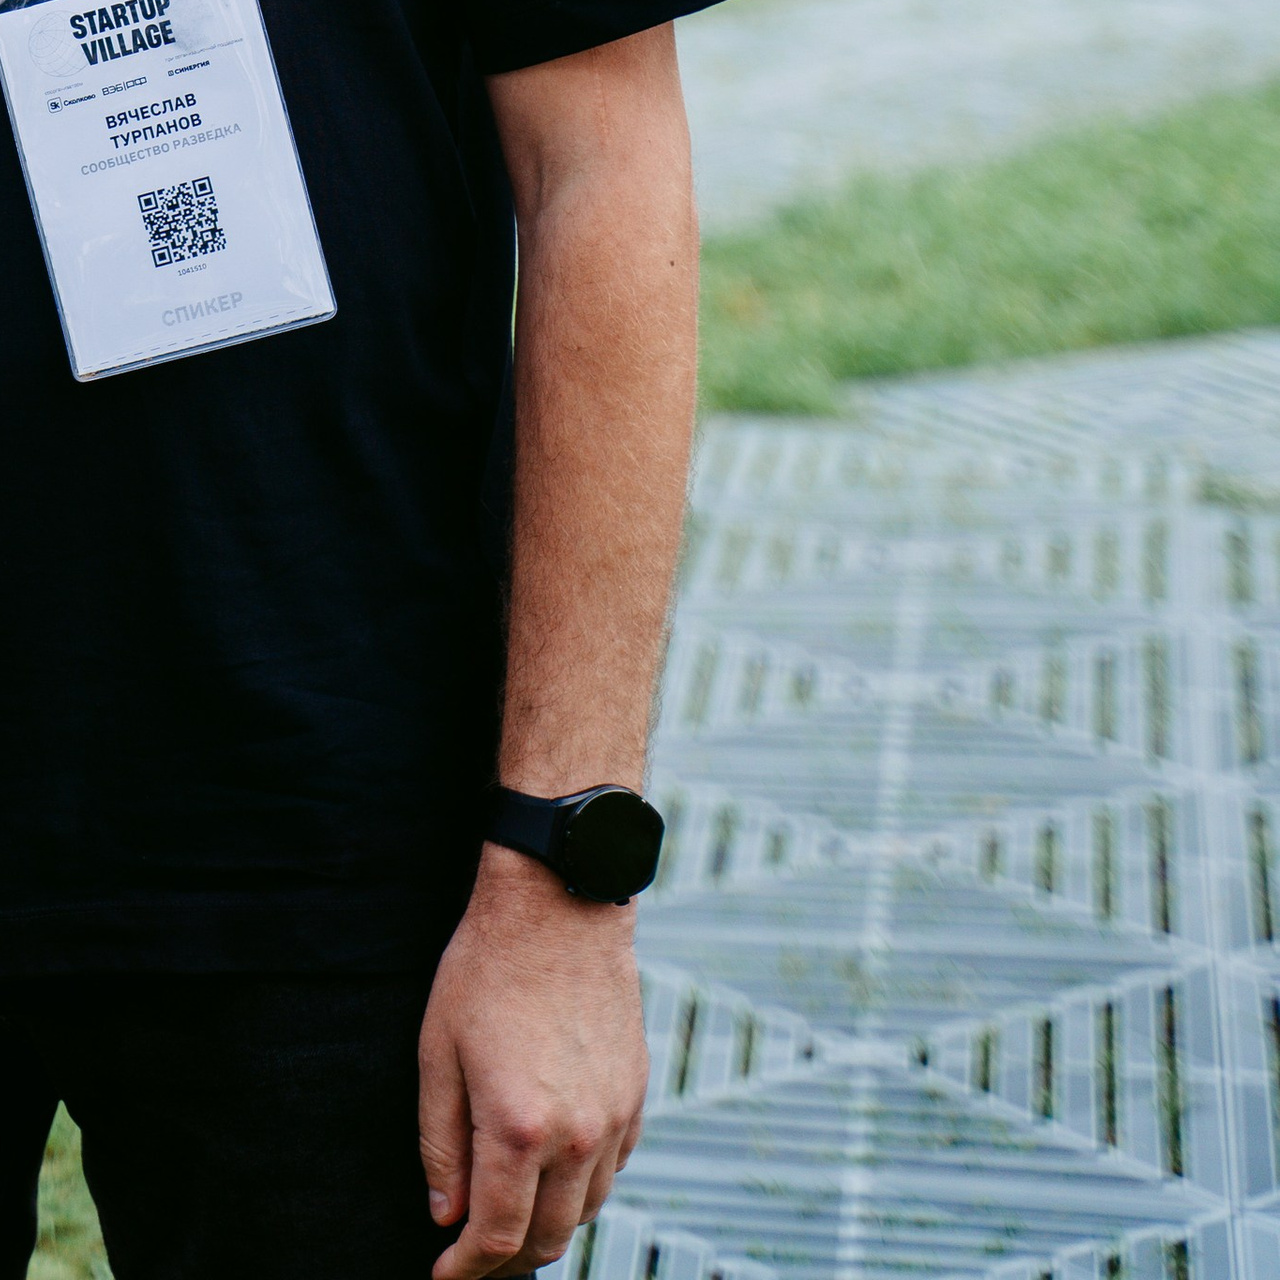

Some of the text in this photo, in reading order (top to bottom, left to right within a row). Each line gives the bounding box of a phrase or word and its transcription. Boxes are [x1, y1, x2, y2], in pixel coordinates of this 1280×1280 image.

[81, 20, 176, 66] VILLAGE
[174, 60, 211, 75] СИНЕРГИЯ
[63, 93, 97, 107] Сколково
[105, 93, 197, 130] ВЯЧЕСЛАВ
[110, 113, 202, 149] ТУРПАНОВ
[81, 123, 242, 176] СООБЩЕСТВО РАЗВЕДКА
[178, 263, 208, 276] 1041510
[161, 291, 243, 327] СПИКЕР
